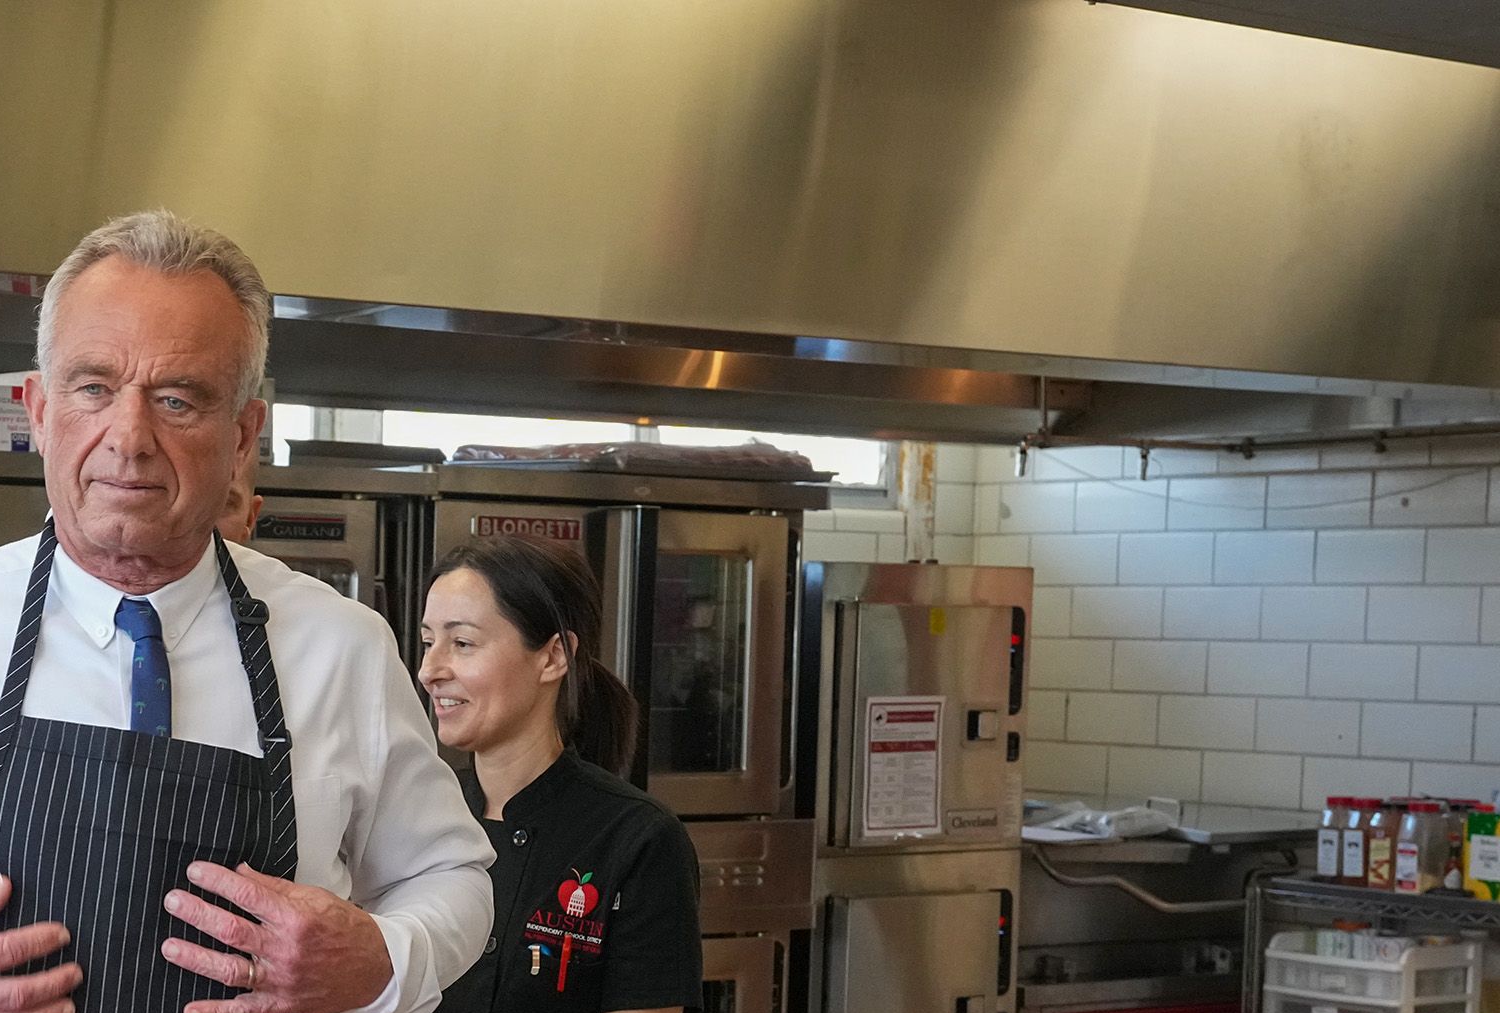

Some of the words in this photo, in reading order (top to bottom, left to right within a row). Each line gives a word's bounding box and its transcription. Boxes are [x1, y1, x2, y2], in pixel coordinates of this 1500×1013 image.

[273, 526, 341, 537] GARLAND
[480, 517, 577, 539] BLODGETT
[952, 814, 997, 828] Cleveland
[526, 923, 564, 936] INDEPENDENT
[529, 910, 604, 937] AUSTIN
